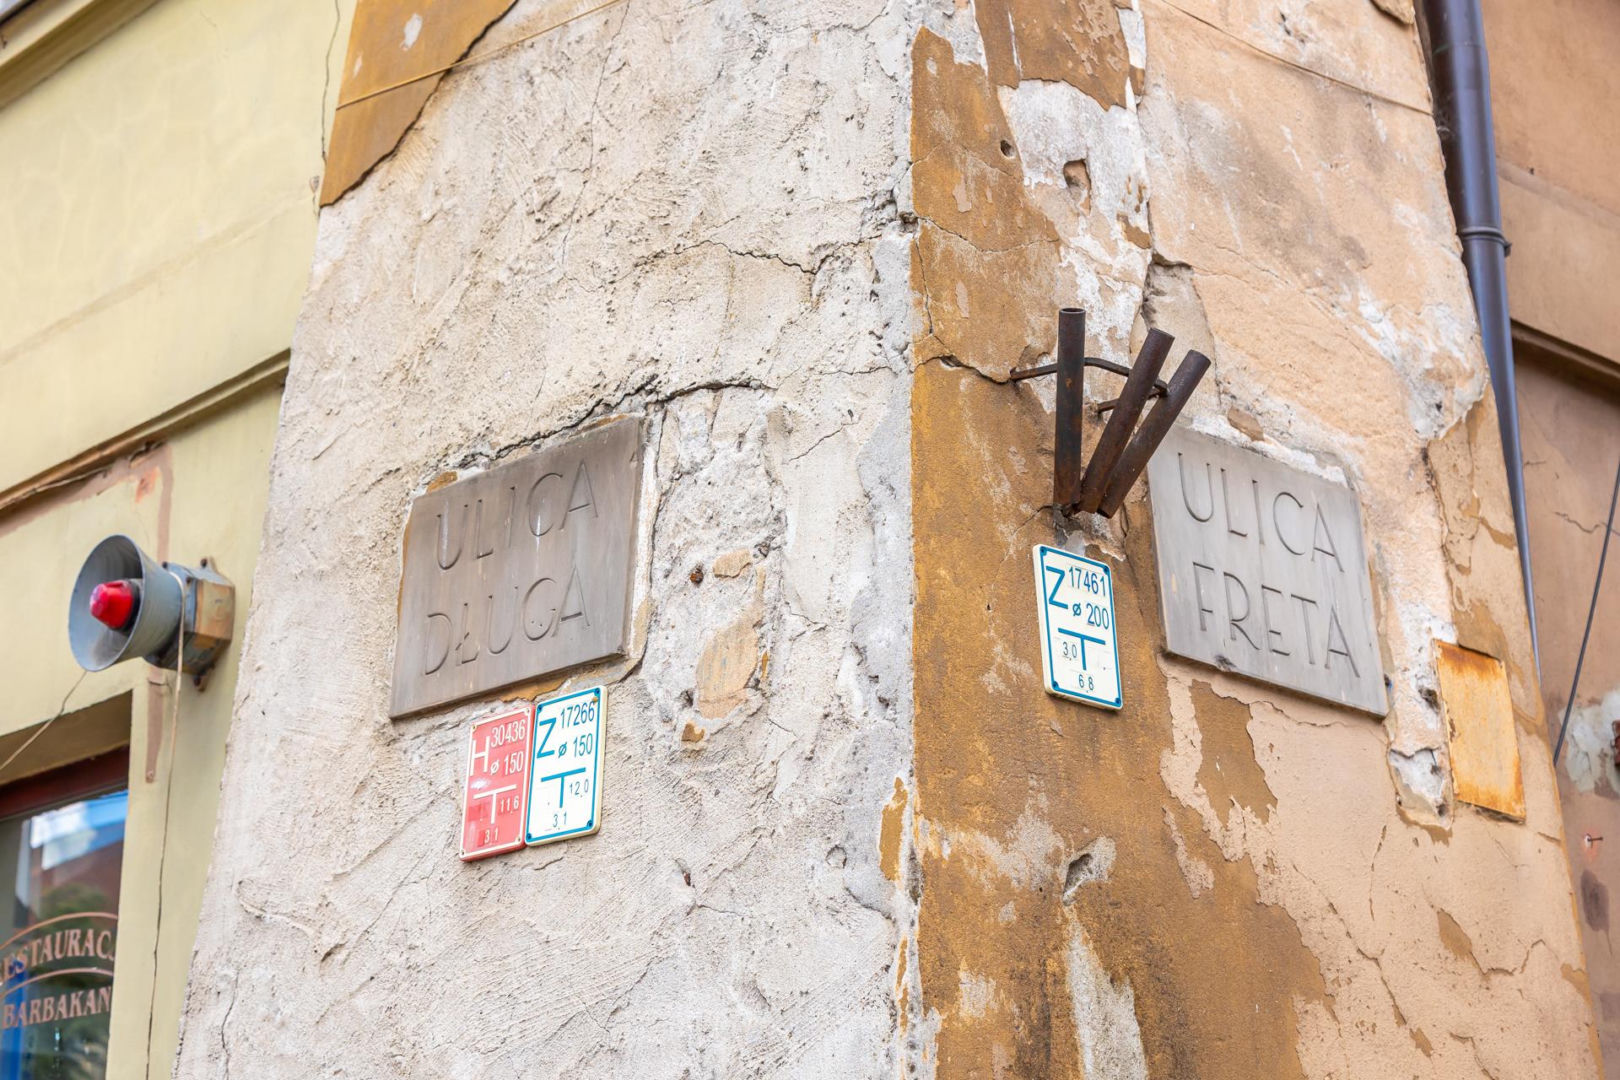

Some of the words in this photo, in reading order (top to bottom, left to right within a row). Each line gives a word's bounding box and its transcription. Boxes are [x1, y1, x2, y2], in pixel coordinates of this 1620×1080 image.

[436, 460, 598, 570] ULICA
[1177, 452, 1345, 573] ULICA
[1046, 565, 1068, 609] Z
[1068, 566, 1106, 597] 17461
[424, 565, 590, 676] DŁUGA
[1086, 603, 1110, 630] 200
[1192, 561, 1360, 678] FRETA
[470, 736, 490, 776] H
[490, 719, 526, 748] 30436
[537, 717, 557, 758] Z
[560, 701, 595, 729] 17266
[573, 733, 593, 758] 150
[504, 751, 524, 775] 150
[2, 986, 112, 1030] BARBAKAN
